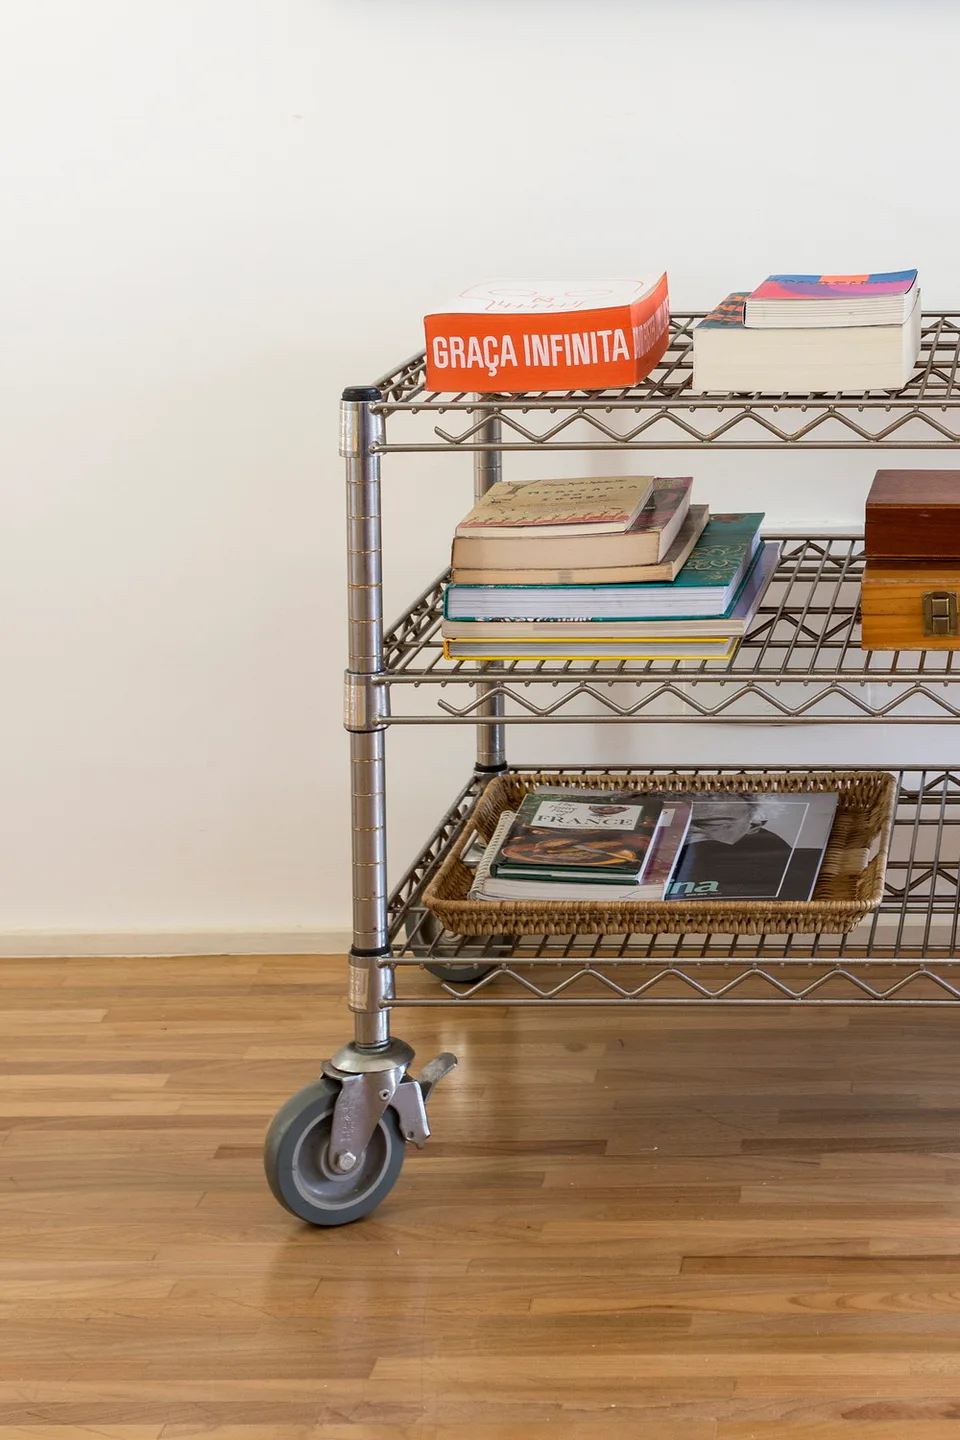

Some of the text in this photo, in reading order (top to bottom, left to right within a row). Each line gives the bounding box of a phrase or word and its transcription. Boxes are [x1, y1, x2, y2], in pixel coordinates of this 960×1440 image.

[432, 329, 630, 376] GRAÇA INFINITA
[536, 815, 633, 826] FRANCE
